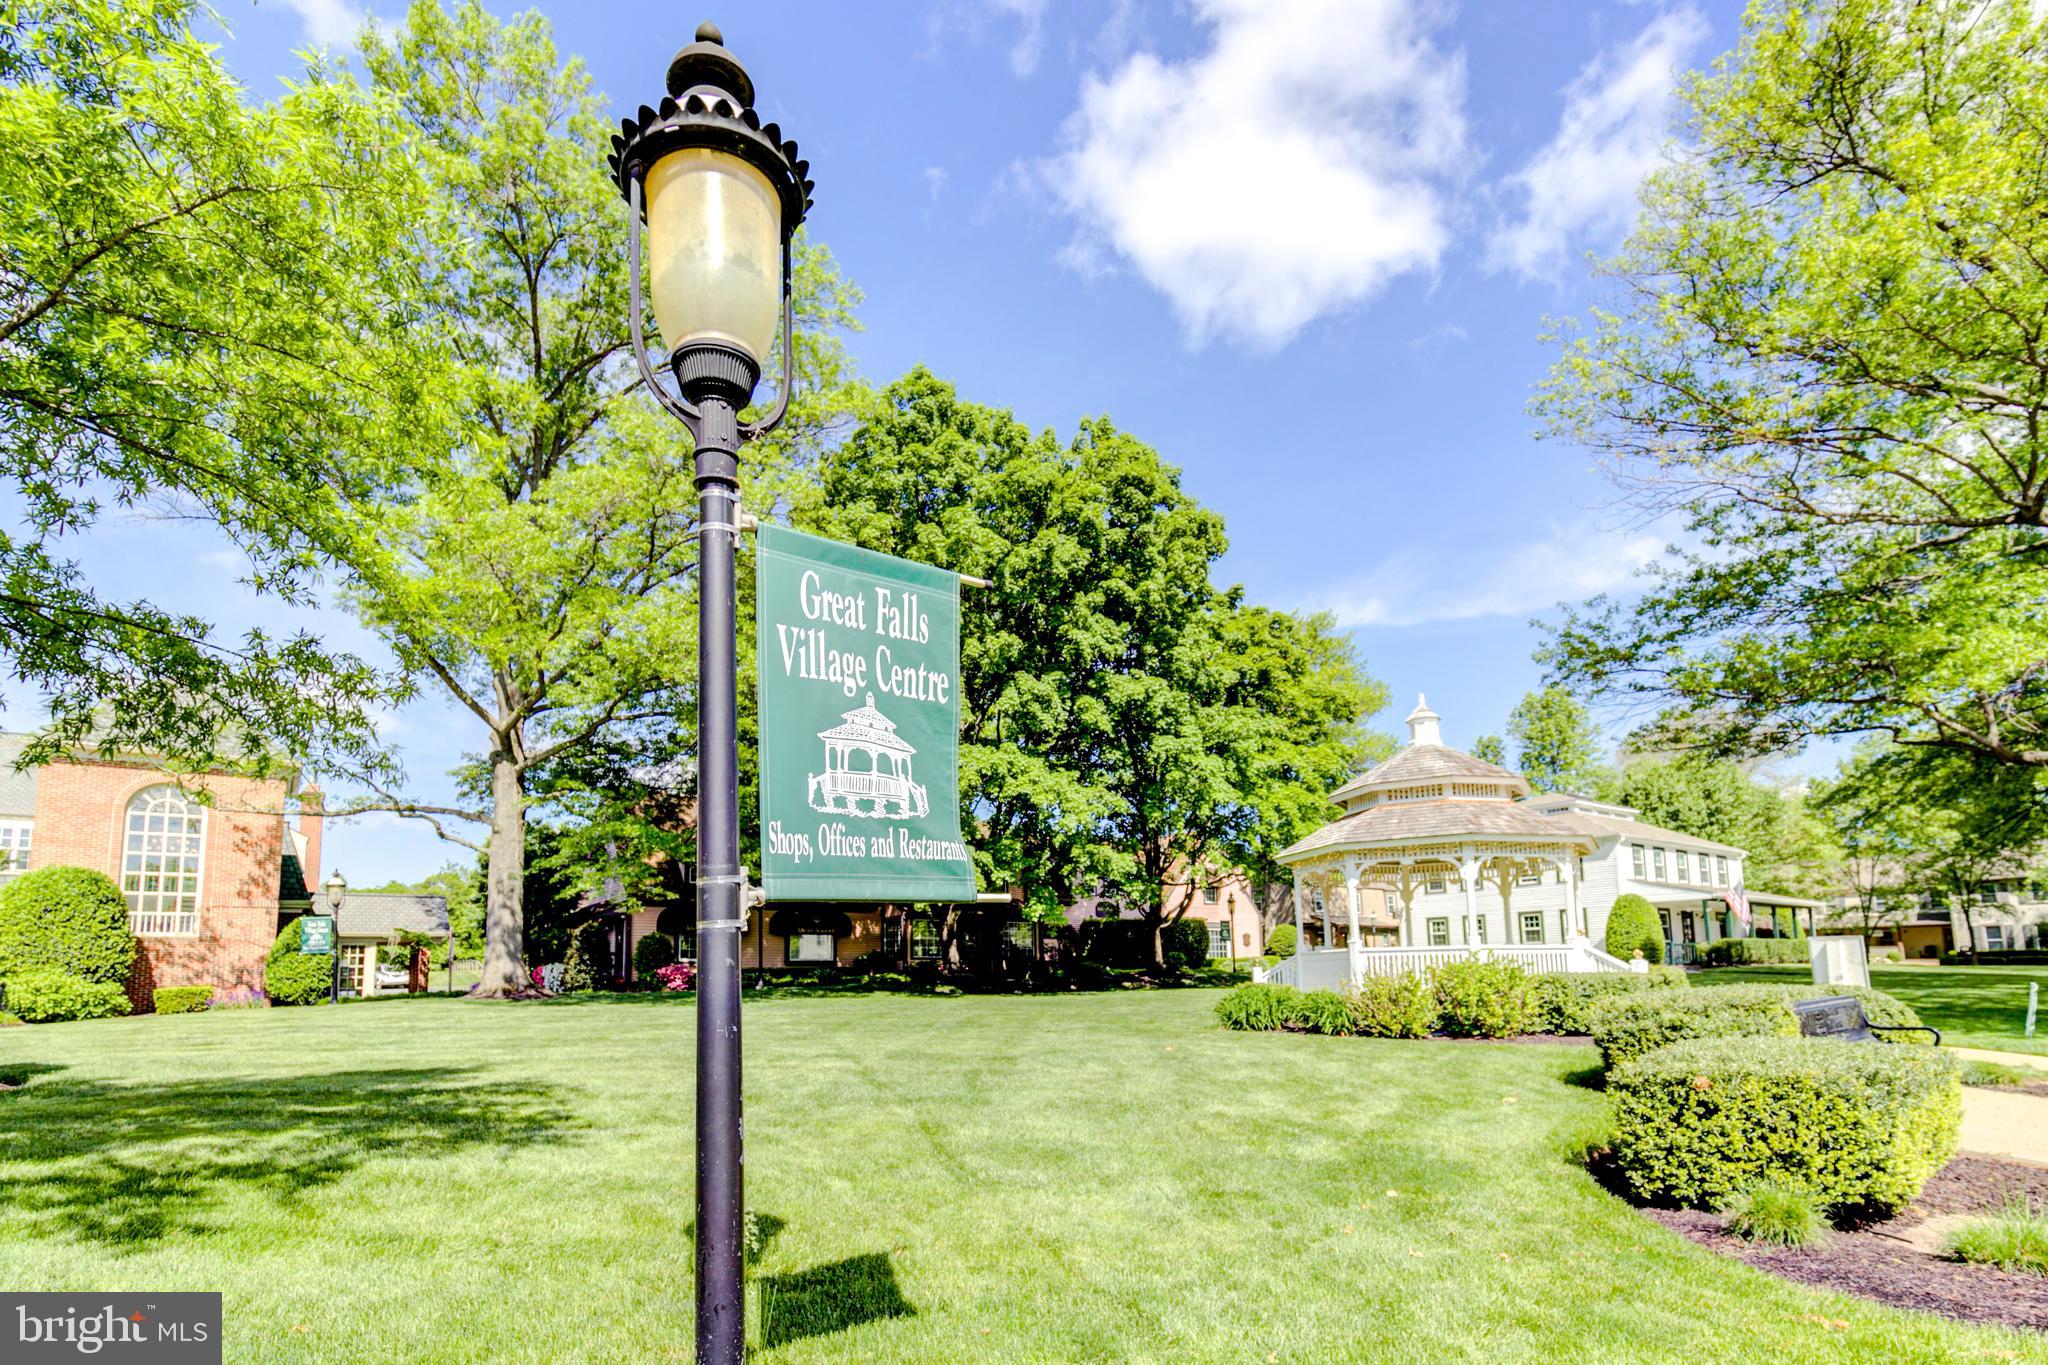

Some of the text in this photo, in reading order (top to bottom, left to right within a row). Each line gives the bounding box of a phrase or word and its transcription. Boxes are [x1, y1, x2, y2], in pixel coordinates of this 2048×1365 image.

[800, 570, 929, 644] Great Falls
[776, 623, 949, 704] Village Centre
[768, 820, 968, 863] Shops, Offices and Restaurants
